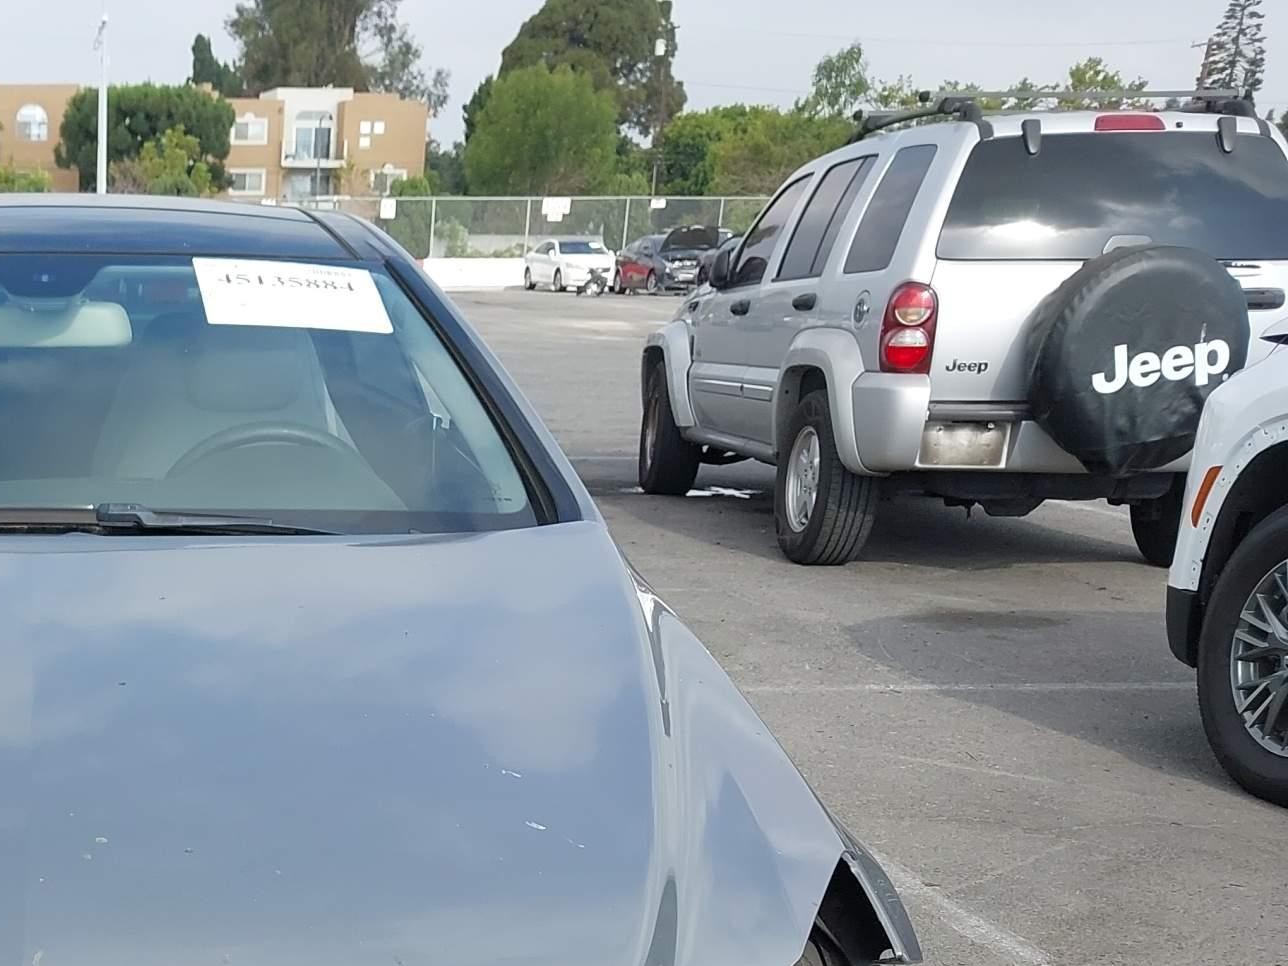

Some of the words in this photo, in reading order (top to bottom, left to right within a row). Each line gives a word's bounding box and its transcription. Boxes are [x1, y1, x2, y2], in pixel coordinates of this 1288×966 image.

[217, 273, 358, 292] 45135884
[945, 358, 989, 375] Jeep
[1091, 339, 1230, 394] Jeep
